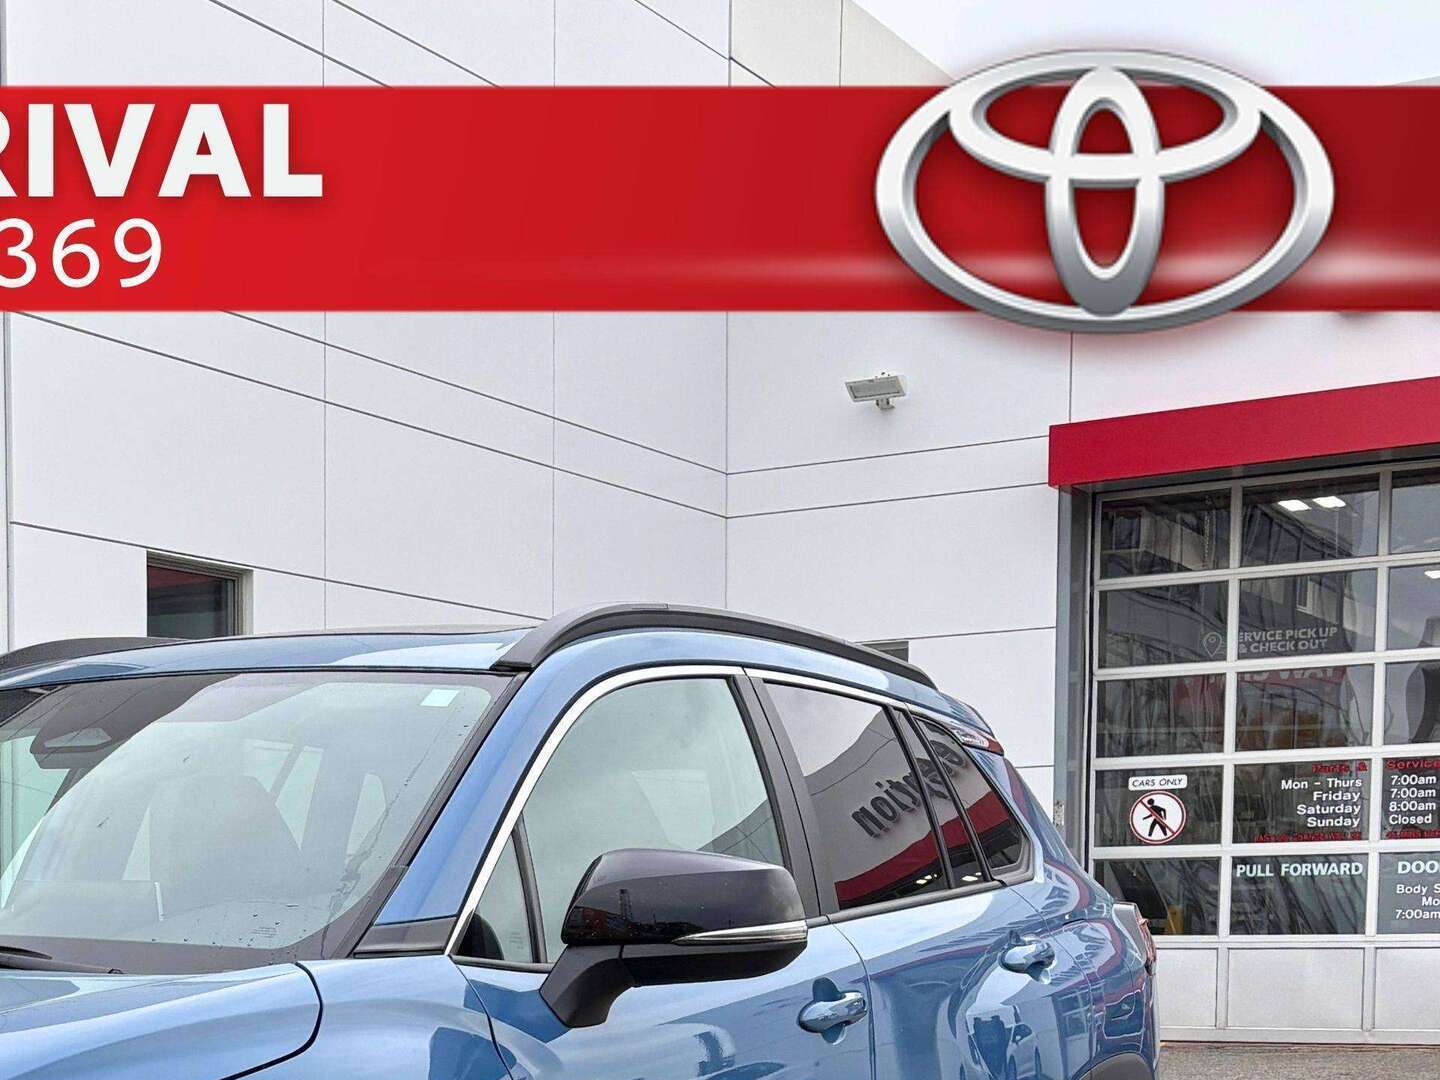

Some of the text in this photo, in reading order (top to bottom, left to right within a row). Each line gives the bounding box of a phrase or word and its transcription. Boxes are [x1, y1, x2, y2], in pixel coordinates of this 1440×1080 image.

[1238, 626, 1338, 643] ERVICE PICK UP
[1250, 640, 1296, 653] CHECK
[1298, 639, 1328, 651] OUT
[1132, 777, 1183, 788] CARS ONLY
[1280, 779, 1308, 790] Mon
[1326, 777, 1362, 788] Thurs
[1390, 774, 1437, 786] 7:00am
[1312, 787, 1437, 803] Friday 7:00am
[1296, 800, 1436, 816] Saturday 8:00am
[1306, 813, 1432, 828] Sunday Closed
[1235, 862, 1364, 877] PULL FORWARD
[1397, 860, 1440, 874] DOO
[1396, 883, 1428, 895] Body
[1395, 908, 1440, 920] 7:00am
